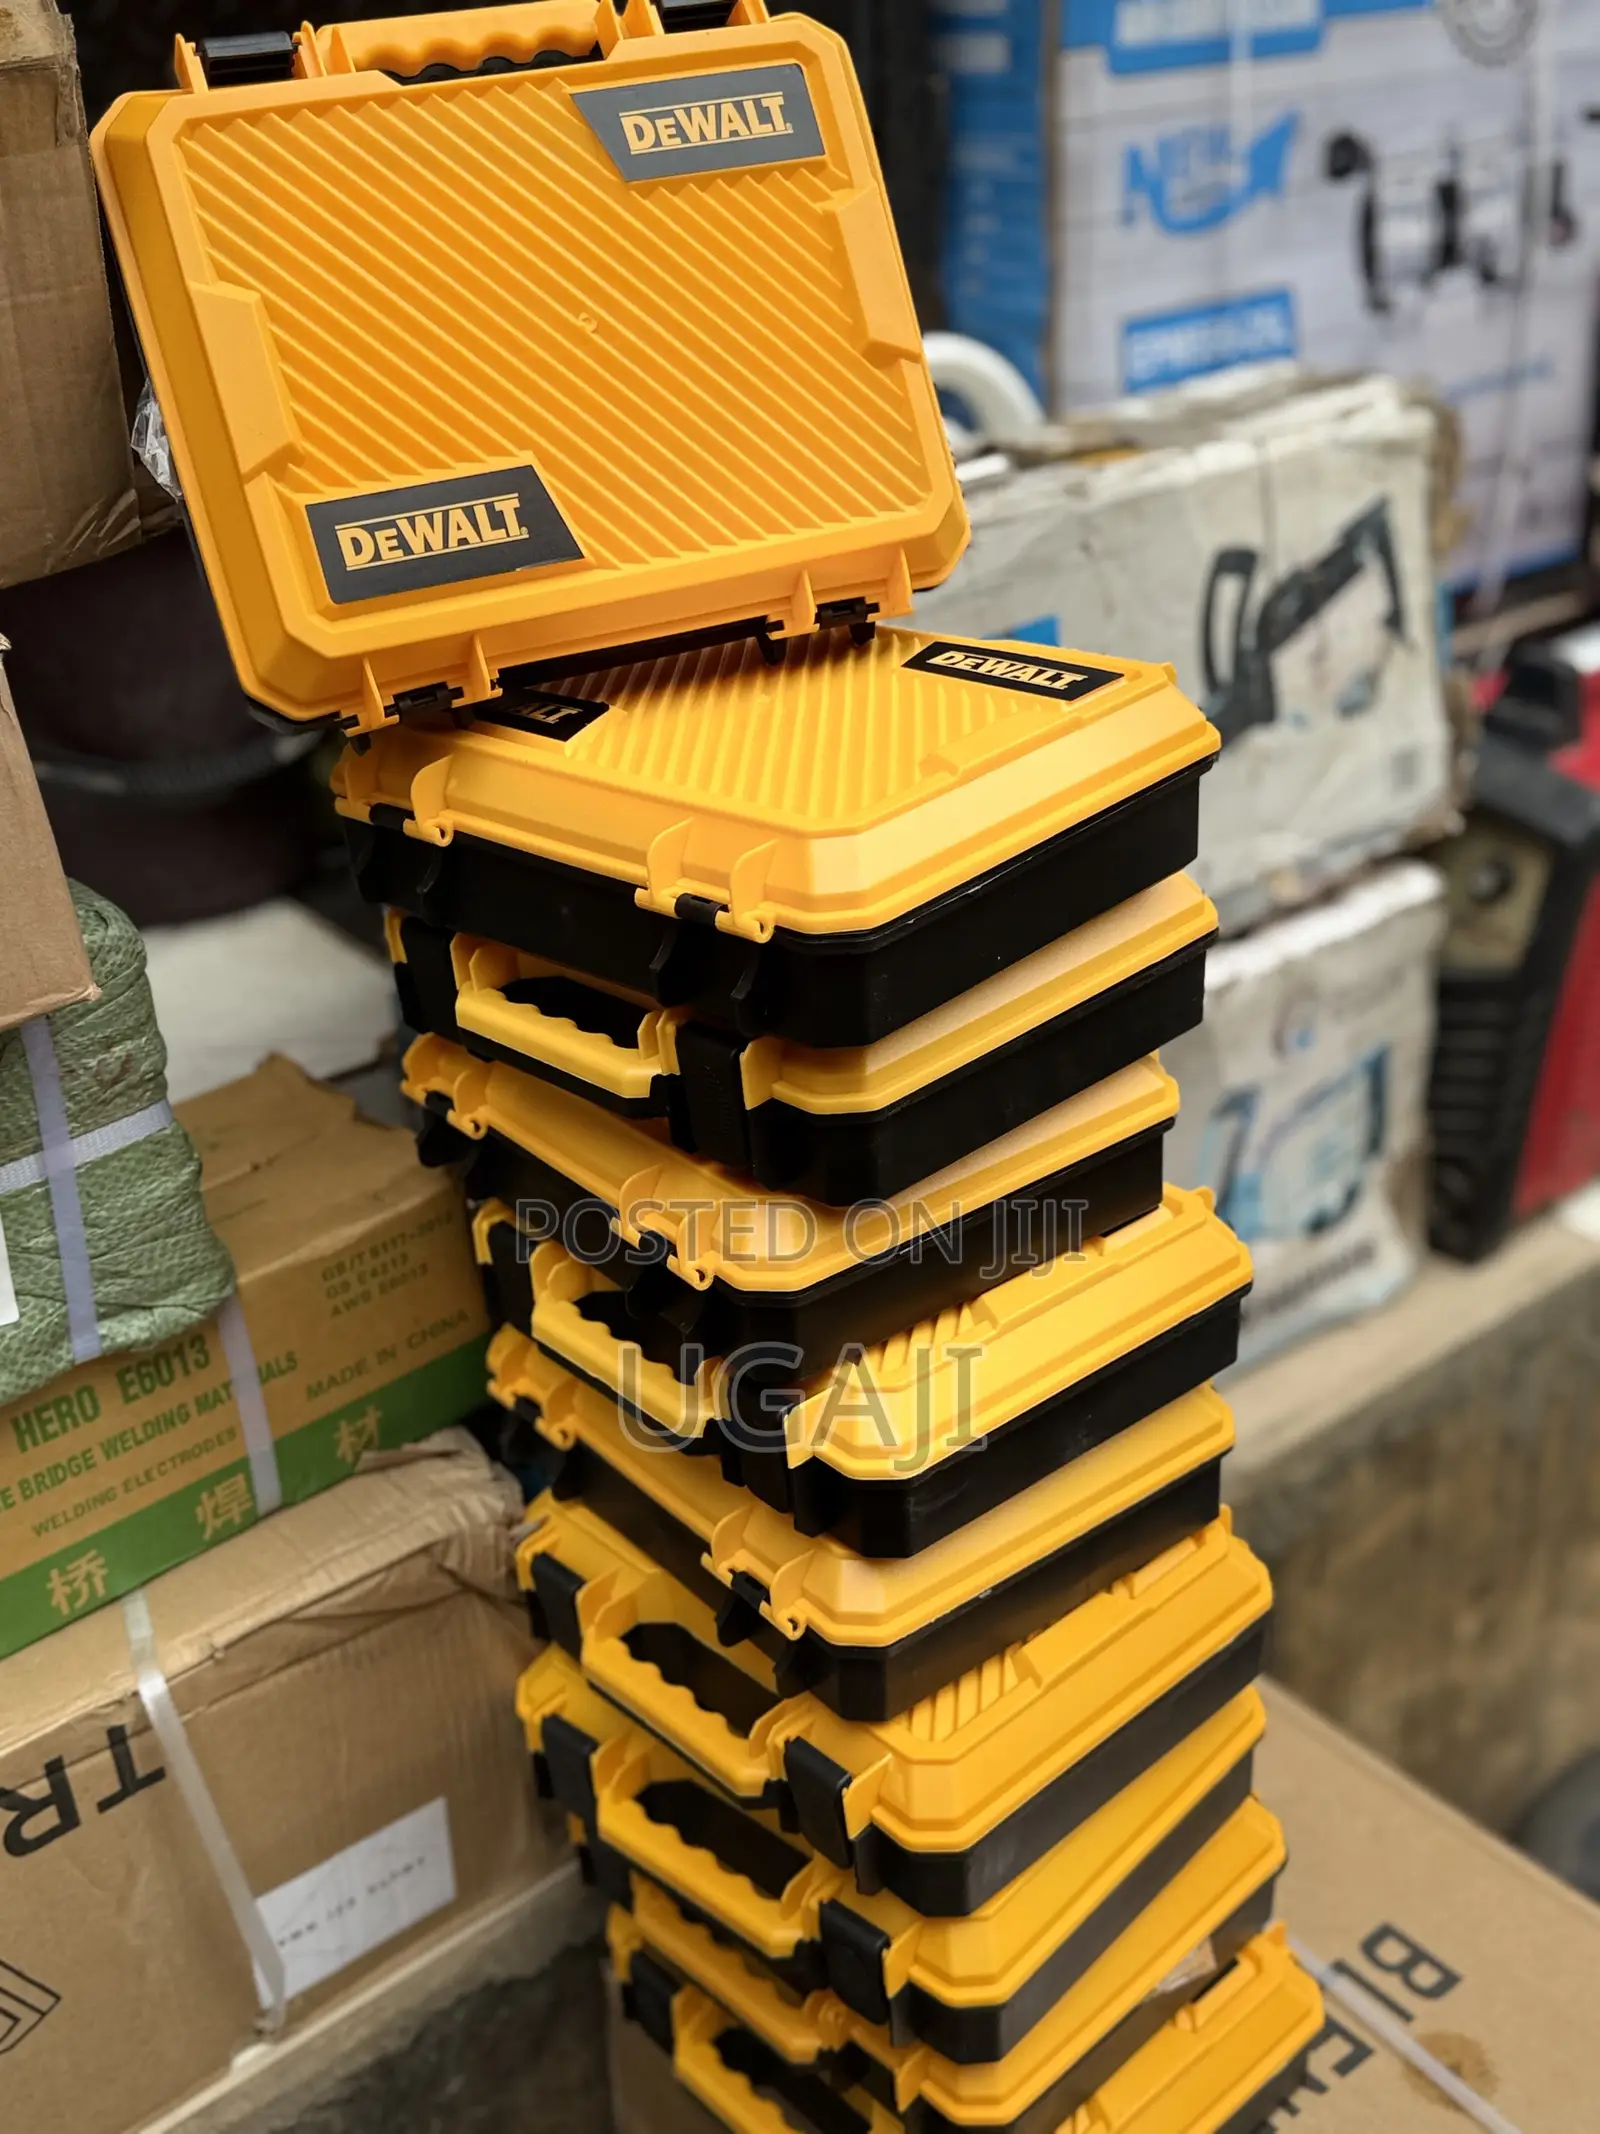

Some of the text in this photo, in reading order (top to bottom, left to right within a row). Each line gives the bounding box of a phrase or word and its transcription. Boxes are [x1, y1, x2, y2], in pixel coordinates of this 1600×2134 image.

[9, 1334, 210, 1453] HERO E6013
[305, 1308, 470, 1401] MADE IN CHINA
[18, 1448, 98, 1502] BRIDGE
[100, 1402, 191, 1462] WELDING
[32, 1427, 238, 1538] WELDING ELECTRODES
[46, 1549, 109, 1617] 桥
[194, 1472, 254, 1541] 焊
